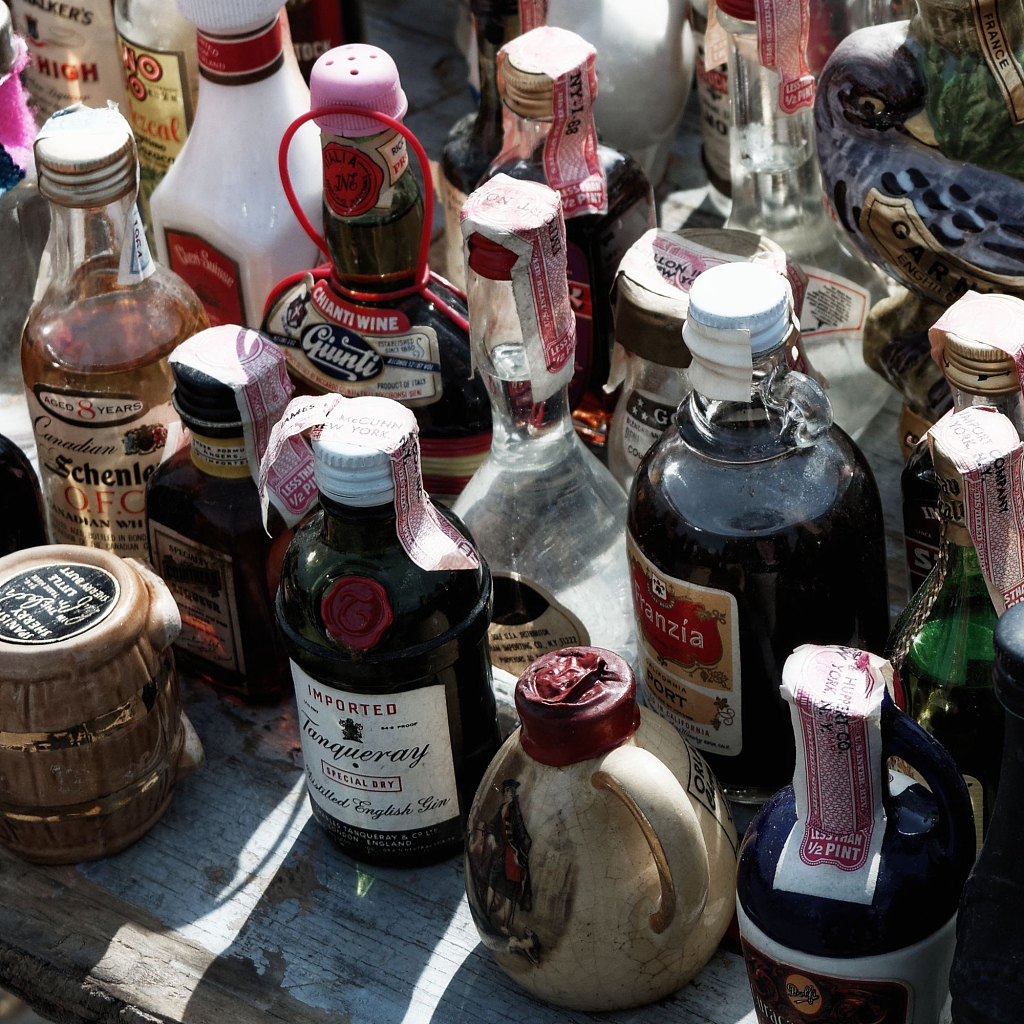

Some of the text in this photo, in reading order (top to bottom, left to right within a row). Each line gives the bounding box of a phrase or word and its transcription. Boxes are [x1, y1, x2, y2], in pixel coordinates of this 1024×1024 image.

[294, 40, 333, 64] TOCK
[982, 11, 1010, 69] FRANCE
[37, 55, 99, 83] HIGH
[312, 286, 400, 332] CHIANTI WINE
[301, 323, 381, 380] Giunti
[44, 395, 143, 420] AGED 8 YEARS
[34, 415, 118, 456] Canadian
[43, 453, 160, 487] Schenle
[205, 456, 249, 466] IMPORTE
[51, 504, 110, 529] ANADIAN
[0, 608, 35, 640] SPANIS
[10, 608, 53, 637] SHERRY
[633, 578, 705, 650] Franzía
[307, 683, 398, 717] IMPORTED
[646, 669, 689, 710] PORT
[665, 708, 711, 738] CALIFORNIA
[301, 709, 431, 769] Tanqueray
[326, 766, 395, 789] SPECIAL DRY
[351, 797, 416, 821] English
[417, 795, 451, 814] Gin
[343, 824, 399, 841] TANQUERAY
[366, 838, 413, 848] ENGLAND
[833, 830, 863, 847] THAN
[825, 843, 861, 862] PINT
